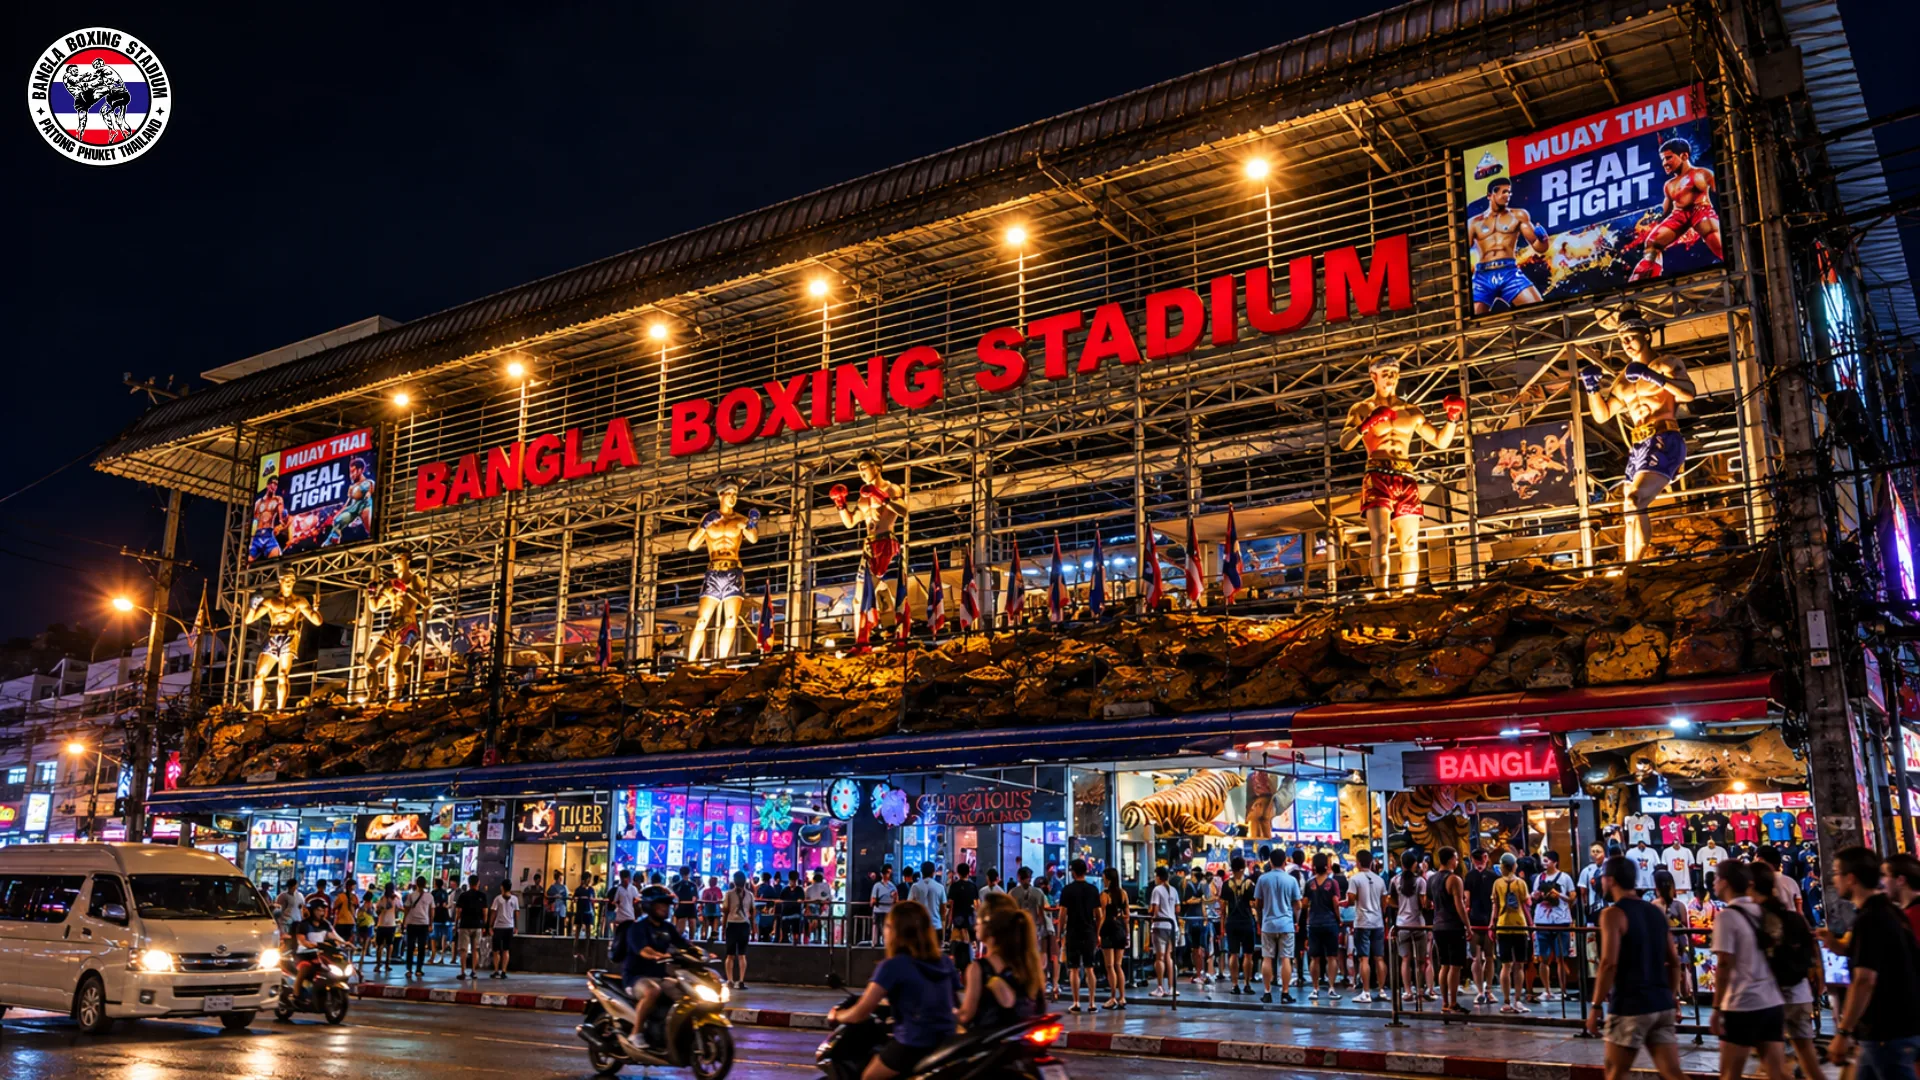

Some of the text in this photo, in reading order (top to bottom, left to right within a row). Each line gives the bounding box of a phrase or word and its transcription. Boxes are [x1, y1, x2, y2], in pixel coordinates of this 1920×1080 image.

[1523, 95, 1687, 165] MUAY THAI
[1541, 145, 1651, 202] REAL
[1548, 172, 1655, 228] FIGHT
[414, 234, 1414, 513] BANGLA BOXING STADIUM
[285, 432, 367, 469] MUAY THAI
[290, 463, 345, 494] REAL
[290, 481, 345, 512] FIGHT
[1439, 750, 1558, 780] BANGLA
